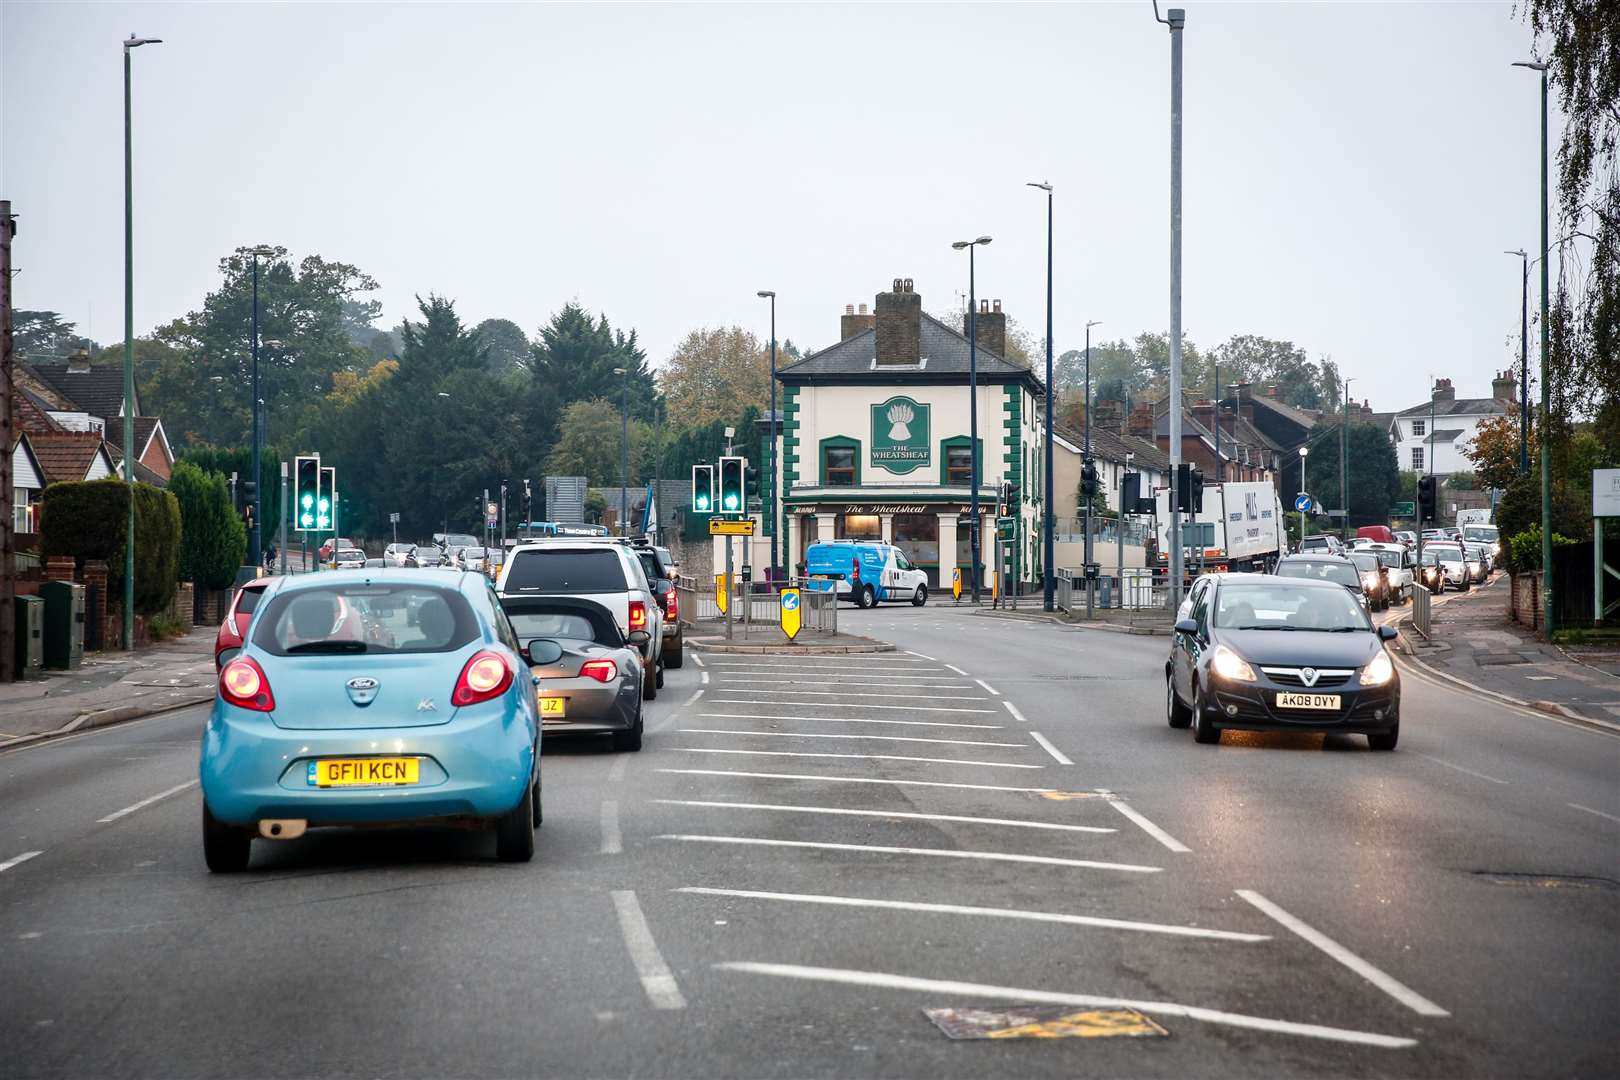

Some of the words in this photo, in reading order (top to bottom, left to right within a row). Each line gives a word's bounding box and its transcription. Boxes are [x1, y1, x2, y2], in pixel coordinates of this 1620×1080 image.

[872, 451, 928, 459] WHEATSHEAF
[844, 504, 864, 513] The
[870, 504, 928, 513] Wheatsheaf
[351, 679, 374, 688] Ford
[540, 700, 557, 711] JZ
[328, 763, 363, 780] GF11
[369, 762, 406, 779] KCN
